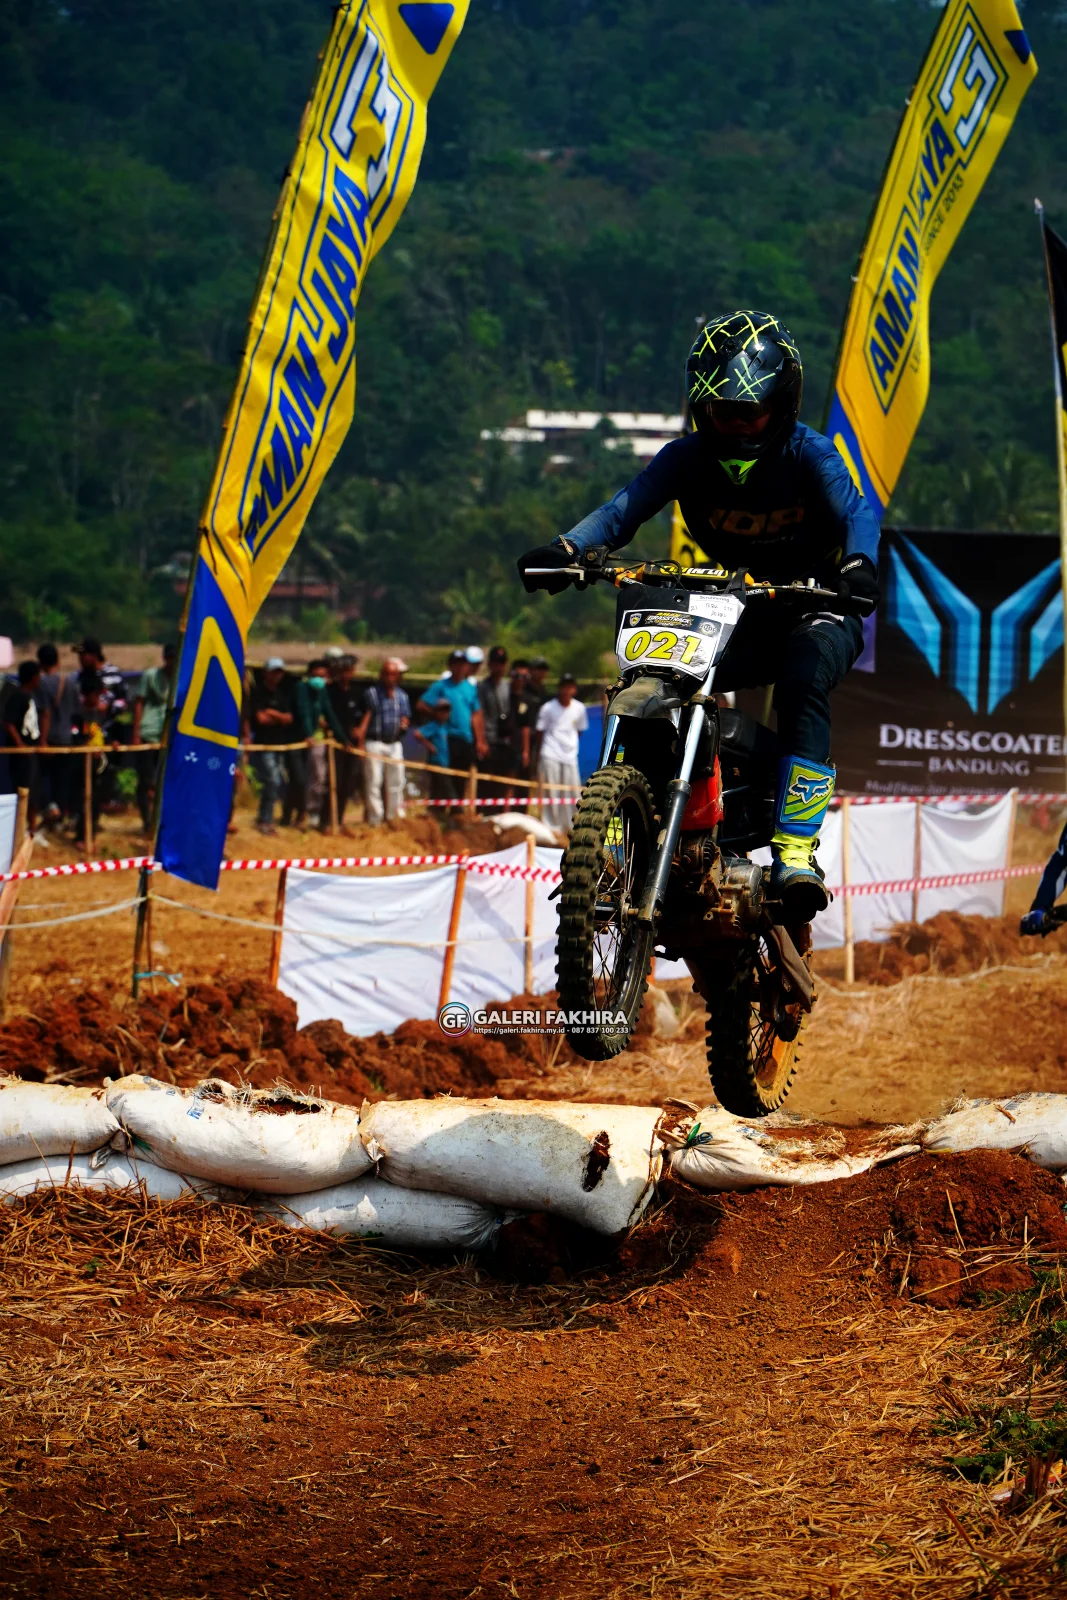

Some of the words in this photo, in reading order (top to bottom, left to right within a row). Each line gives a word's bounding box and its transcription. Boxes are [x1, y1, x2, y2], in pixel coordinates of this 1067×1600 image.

[942, 171, 965, 213] 2013
[625, 630, 701, 665] 021
[928, 756, 1030, 777] BANDUNG
